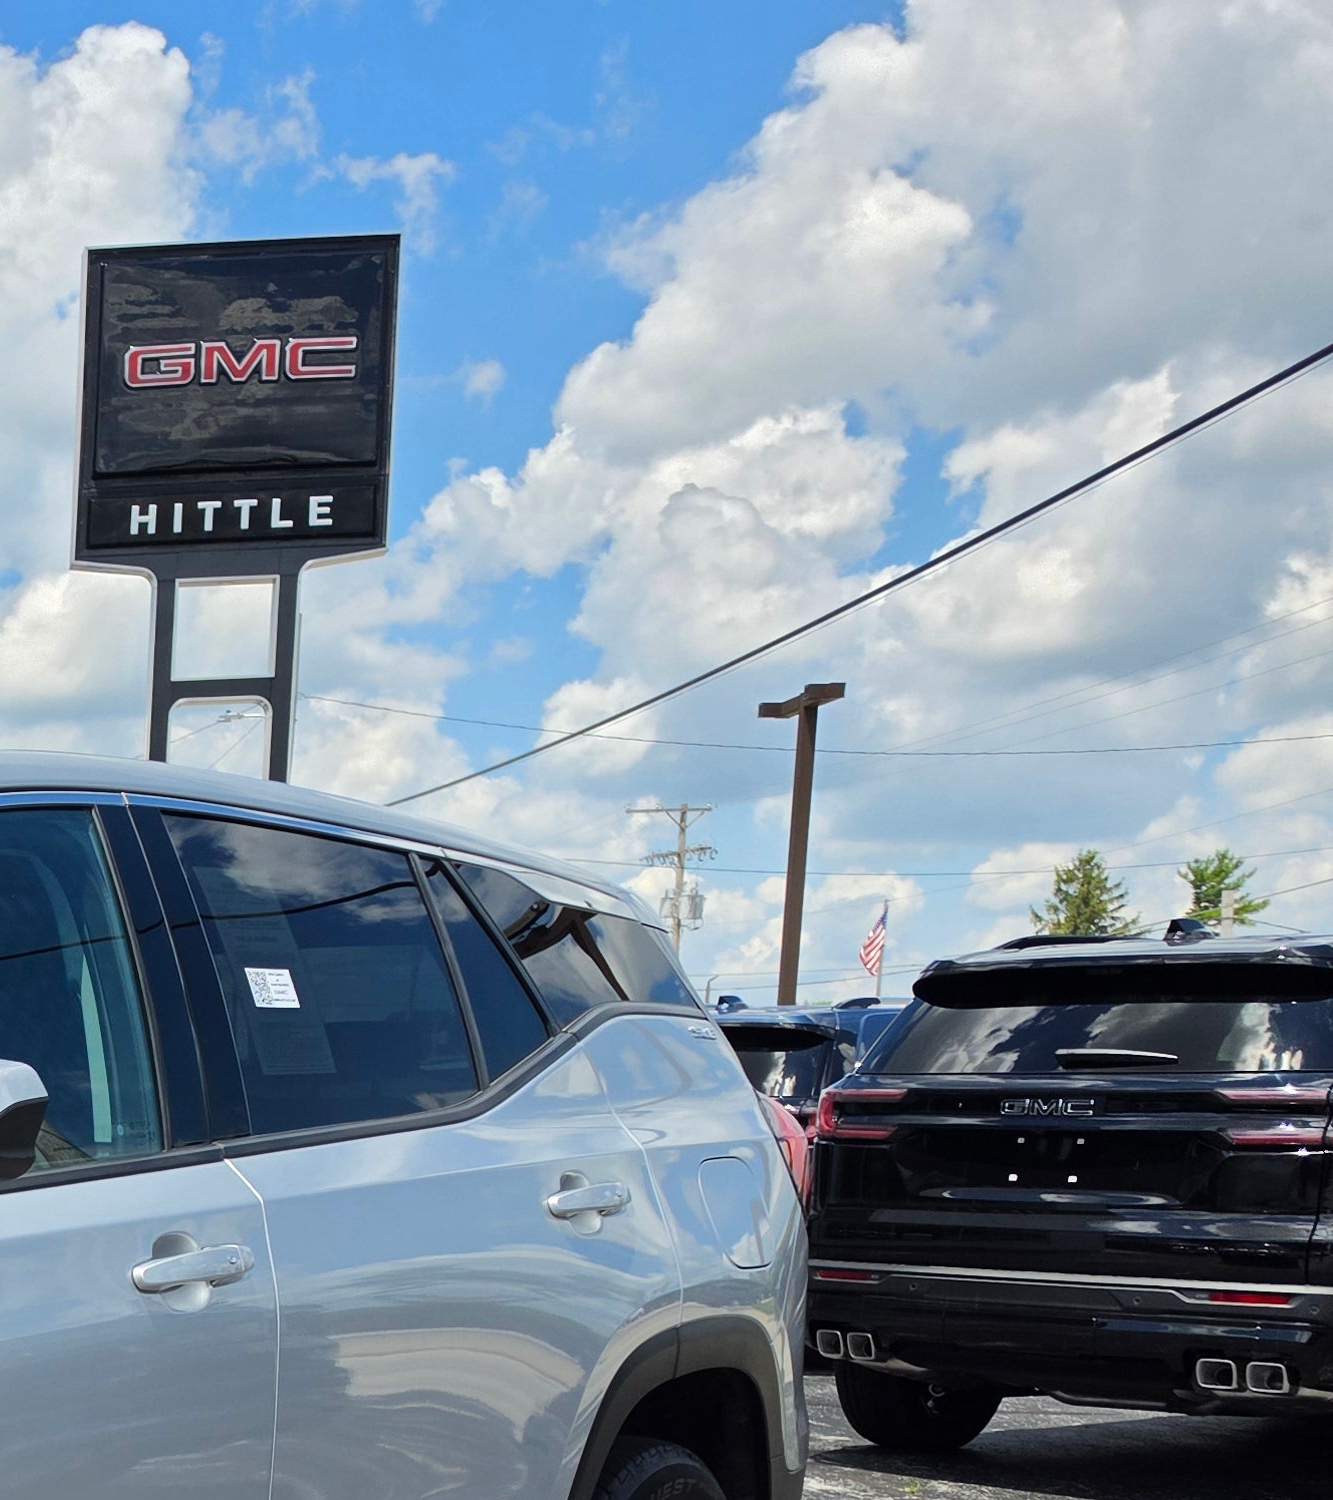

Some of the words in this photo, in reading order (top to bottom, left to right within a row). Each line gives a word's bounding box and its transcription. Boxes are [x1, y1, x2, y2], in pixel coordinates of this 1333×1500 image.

[124, 336, 357, 388] GMC
[130, 495, 334, 535] HITTLE
[1000, 1098, 1095, 1116] GMC
